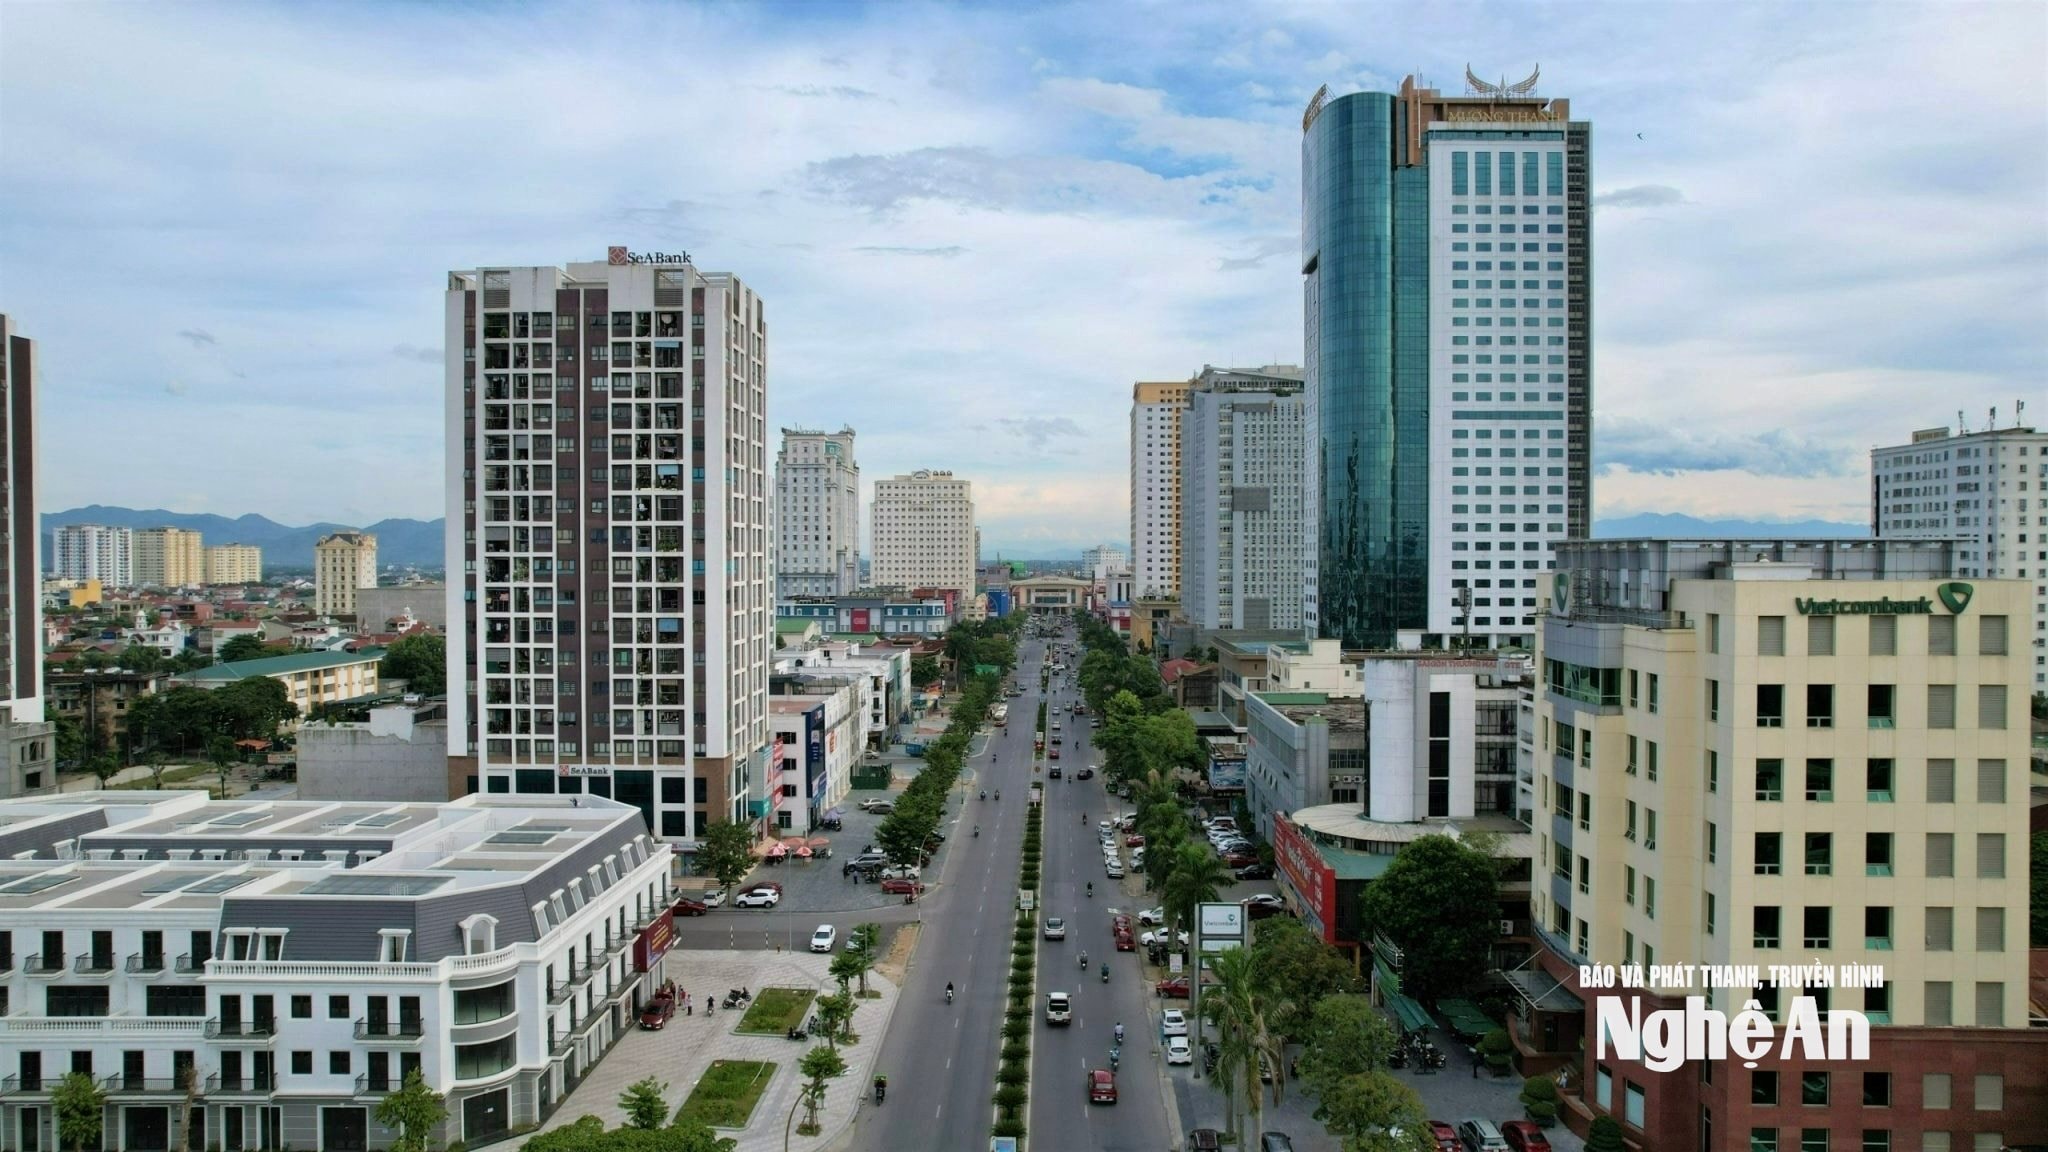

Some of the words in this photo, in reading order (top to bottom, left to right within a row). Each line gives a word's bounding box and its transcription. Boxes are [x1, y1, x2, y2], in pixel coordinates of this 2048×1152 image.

[1507, 111, 1561, 122] THANH
[627, 250, 691, 264] SeABank
[1795, 596, 1933, 615] Vietcombank
[570, 766, 609, 775] SeABank
